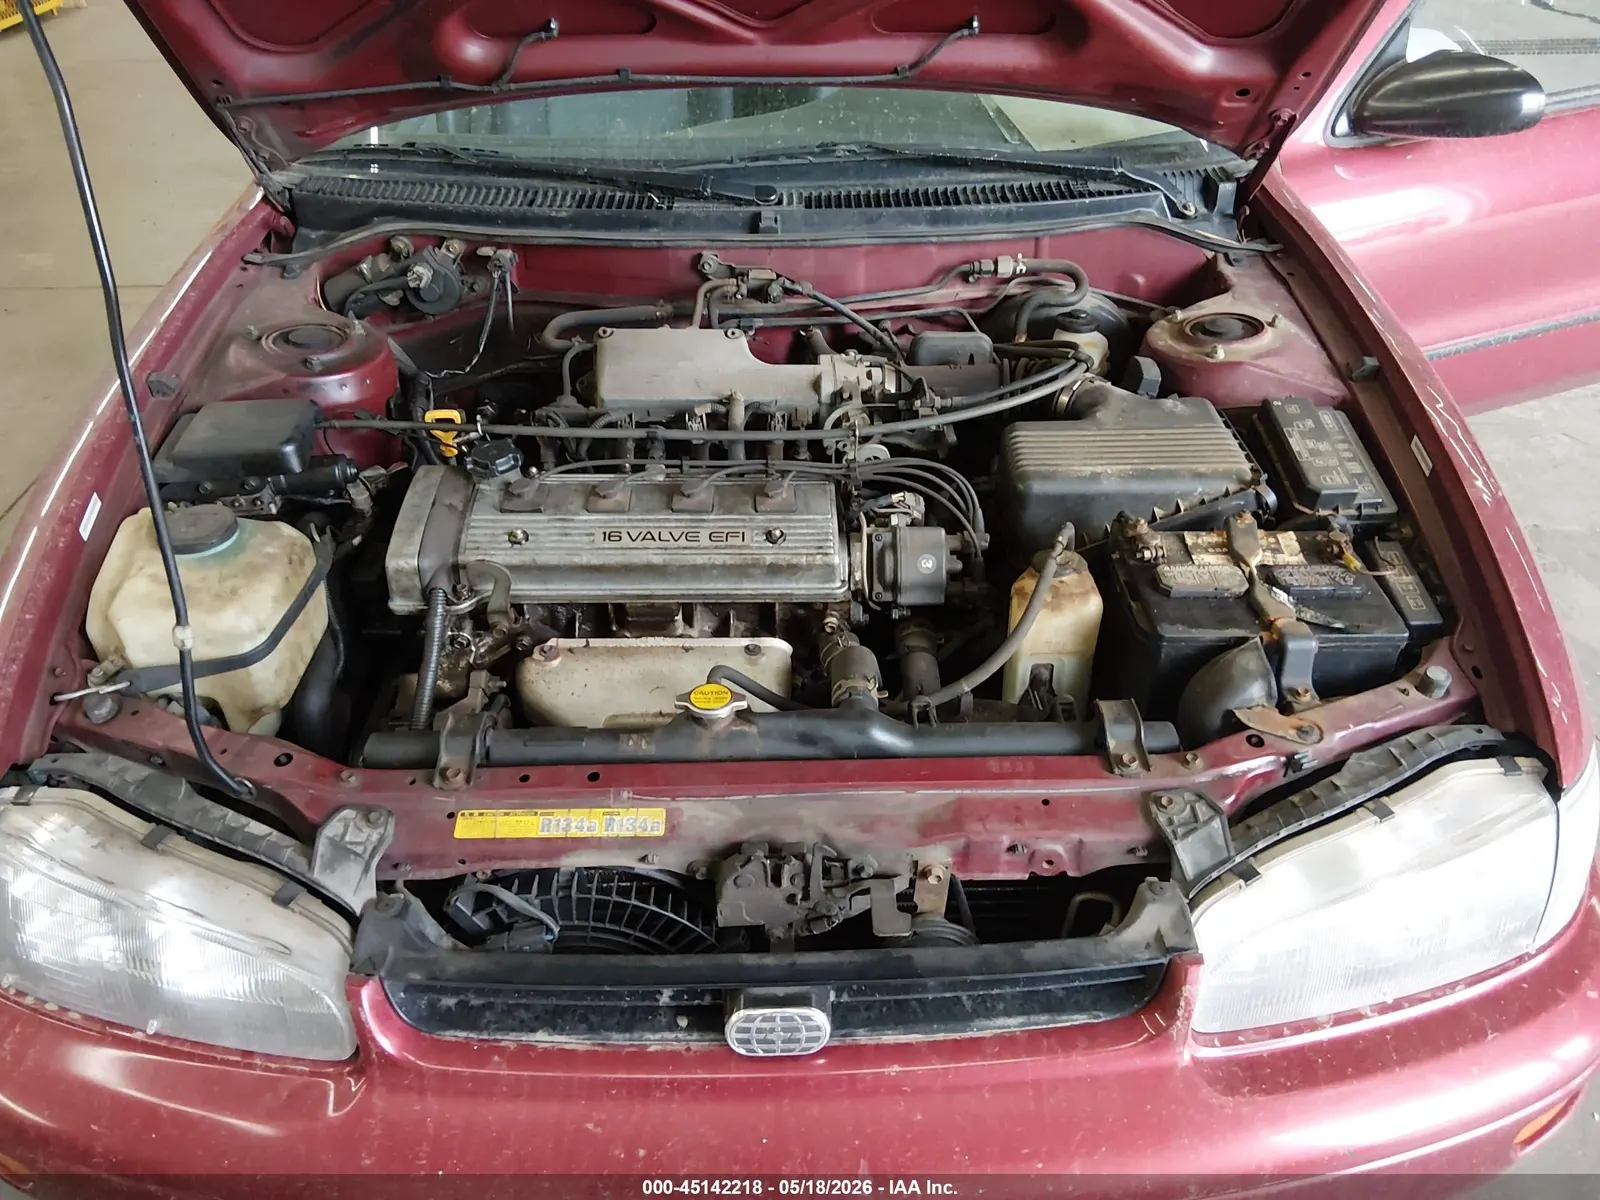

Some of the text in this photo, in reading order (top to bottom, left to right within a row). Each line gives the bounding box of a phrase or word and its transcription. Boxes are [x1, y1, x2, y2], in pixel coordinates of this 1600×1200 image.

[602, 531, 746, 542] 16 VALVE EFI
[540, 816, 597, 833] R134a
[603, 816, 661, 833] R134a
